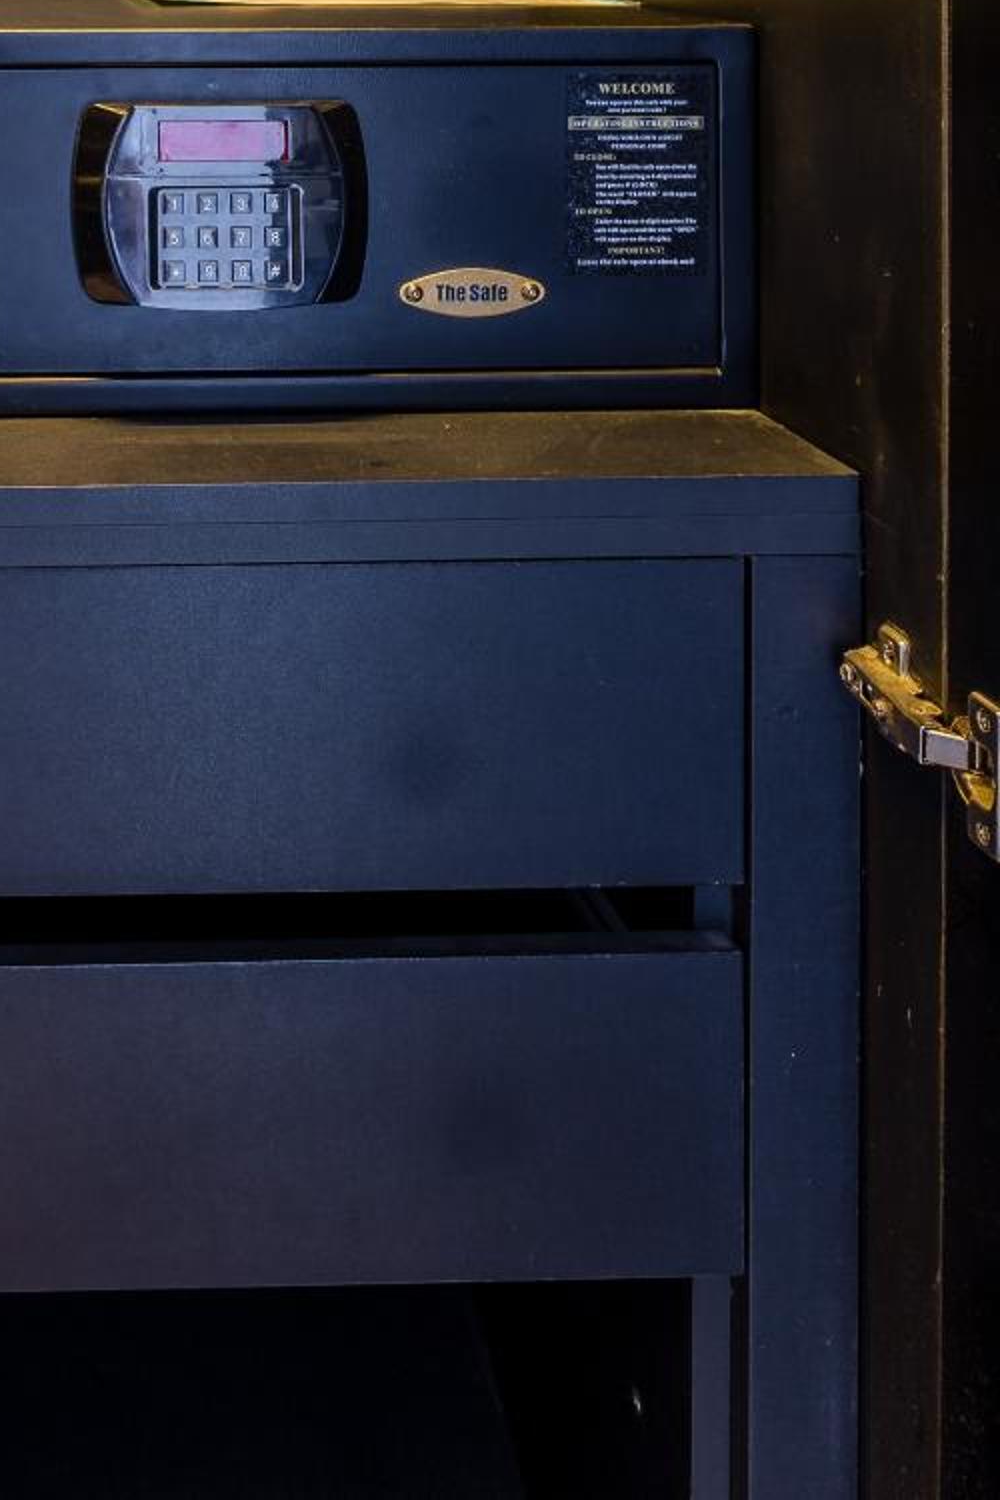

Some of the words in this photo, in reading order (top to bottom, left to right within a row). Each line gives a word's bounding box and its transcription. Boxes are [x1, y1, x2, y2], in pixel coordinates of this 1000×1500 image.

[599, 83, 676, 95] WELCOME
[203, 198, 212, 211] 2
[237, 197, 246, 211] 3
[171, 231, 179, 245] 5
[203, 231, 213, 245] 6
[238, 231, 247, 245] 7
[271, 231, 281, 246] 8
[205, 264, 214, 278] 9
[436, 284, 466, 301] The
[469, 284, 509, 301] Safe
